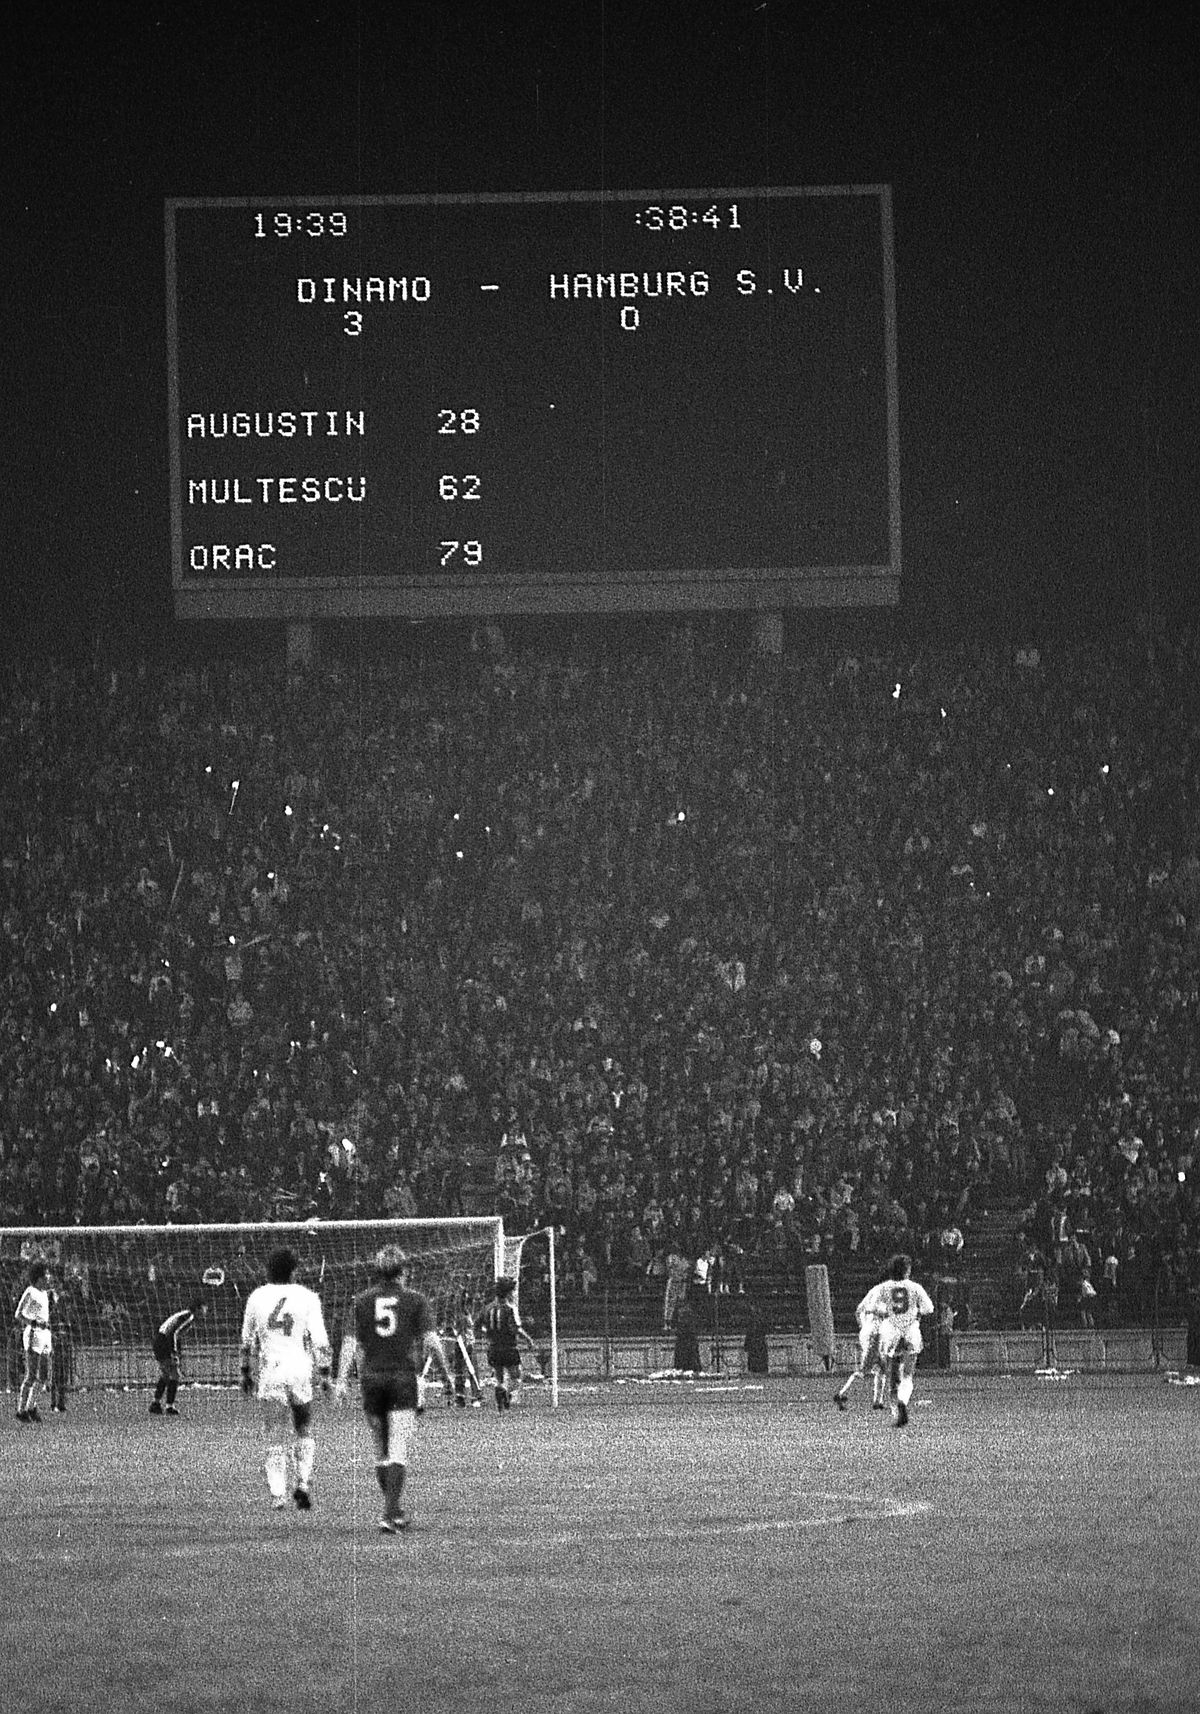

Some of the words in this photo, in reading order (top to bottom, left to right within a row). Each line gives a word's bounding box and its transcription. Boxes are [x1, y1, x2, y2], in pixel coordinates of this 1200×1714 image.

[254, 212, 347, 238] 19:39
[297, 276, 431, 303] DINAMO
[550, 270, 709, 299] HAMBURG
[736, 268, 822, 295] S.V.
[343, 310, 363, 336] 3
[620, 305, 640, 331] 0
[187, 410, 365, 438] AUGUSTIN
[437, 408, 481, 434] 28
[188, 476, 367, 504] MULTESCU
[438, 474, 482, 501] 62
[190, 543, 277, 570] ORAC
[440, 540, 483, 566] 79
[892, 1287, 909, 1315] 9
[267, 1297, 295, 1337] 4
[375, 1297, 398, 1337] 5
